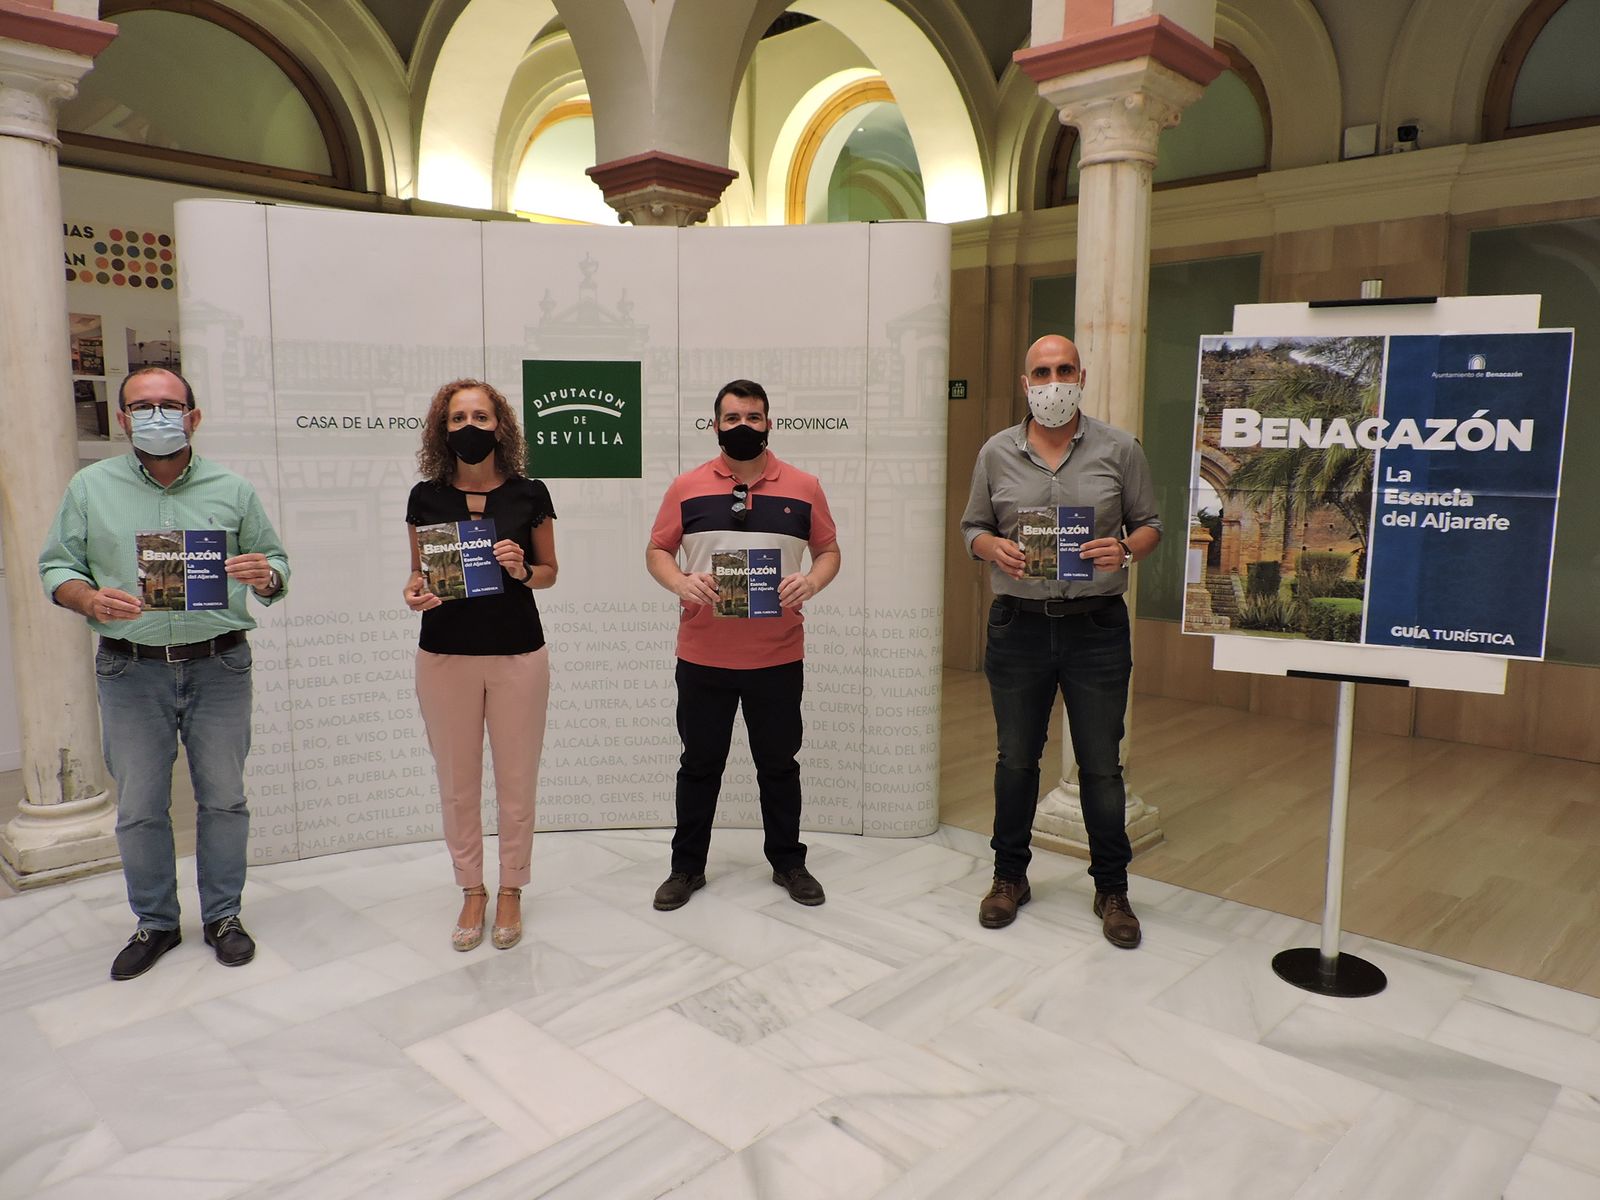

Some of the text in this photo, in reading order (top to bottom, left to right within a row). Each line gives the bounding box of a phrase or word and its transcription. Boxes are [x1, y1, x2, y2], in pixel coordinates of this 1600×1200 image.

[63, 223, 94, 239] IAS
[1431, 371, 1474, 379] Ayuntamiento
[533, 388, 626, 409] DIPUTACION
[296, 416, 338, 428] CASA
[343, 416, 362, 429] DE
[367, 417, 384, 429] LA
[573, 416, 587, 424] DE
[777, 418, 849, 430] PROVINCIA
[1220, 408, 1534, 452] BENACAZÓN
[537, 431, 623, 445] SEVILLA
[1386, 466, 1411, 482] La
[1384, 488, 1474, 507] Esencia
[1023, 525, 1089, 535] BENACAZÓN
[1382, 511, 1510, 533] del Aljarafe
[143, 549, 222, 561] BENACAZÓN
[423, 538, 492, 555] BENACAZÓN
[716, 566, 776, 576] BENACAZÓN
[271, 610, 353, 628] MADROÑO,
[359, 612, 375, 622] LA
[583, 602, 638, 613] CAZALLA
[641, 602, 657, 612] DE
[849, 606, 870, 618] LAS
[875, 608, 917, 618] NAVAS
[286, 631, 354, 648] ALMADÉN
[360, 631, 378, 642] DE
[383, 629, 399, 640] LA
[554, 622, 598, 634] ROSAL,
[603, 622, 617, 632] LA
[845, 625, 877, 639] LORA
[882, 628, 904, 639] DEL
[1391, 625, 1515, 646] GUÍA TURÍSTICA
[308, 656, 334, 668] DEL
[339, 651, 366, 664] RÍO,
[574, 642, 581, 651] Y
[586, 640, 630, 653] MINAS,
[823, 641, 848, 656] RÍO,
[853, 647, 927, 659] MARCHENA,
[266, 681, 283, 692] LA
[288, 677, 338, 690] PUEBLA
[343, 673, 360, 684] DE
[564, 661, 613, 672] CORIPE,
[275, 700, 313, 712] LORA
[318, 696, 336, 708] DE
[341, 692, 391, 705] ESTEPA,
[571, 676, 618, 690] MARTÍN
[624, 680, 639, 689] DE
[644, 680, 658, 689] LA
[817, 682, 876, 698] SAUCEJO,
[288, 719, 314, 732] LOS
[318, 712, 384, 727] MOLARES,
[388, 709, 413, 721] LOS
[584, 699, 632, 710] UTRERA,
[636, 698, 656, 708] LAS
[819, 702, 870, 717] CUERVO,
[875, 707, 903, 717] DOS
[272, 743, 298, 755] DEL
[303, 737, 331, 750] RÍO,
[336, 735, 350, 746] EL
[355, 730, 388, 743] VISO
[392, 728, 417, 739] DEL
[564, 718, 610, 729] ALCOR,
[615, 718, 628, 727] EL
[812, 720, 828, 731] DE
[832, 722, 855, 733] LOS
[333, 750, 386, 766] BRENES,
[390, 748, 406, 759] LA
[604, 737, 620, 747] DE
[895, 745, 917, 756] DEL
[261, 784, 287, 796] DEL
[327, 776, 343, 787] LA
[348, 769, 397, 783] PUEBLA
[402, 766, 426, 778] DEL
[556, 758, 570, 767] LA
[574, 755, 627, 767] ALGABA,
[909, 764, 921, 774] LA
[337, 794, 362, 806] DEL
[366, 785, 424, 802] ARISCAL,
[346, 806, 419, 824] CASTILLEJA
[600, 792, 647, 804] GELVES,
[255, 847, 273, 858] DE
[406, 824, 434, 836] SAN
[600, 810, 663, 822] TOMARES,
[818, 815, 833, 825] DE
[841, 816, 855, 826] LA
